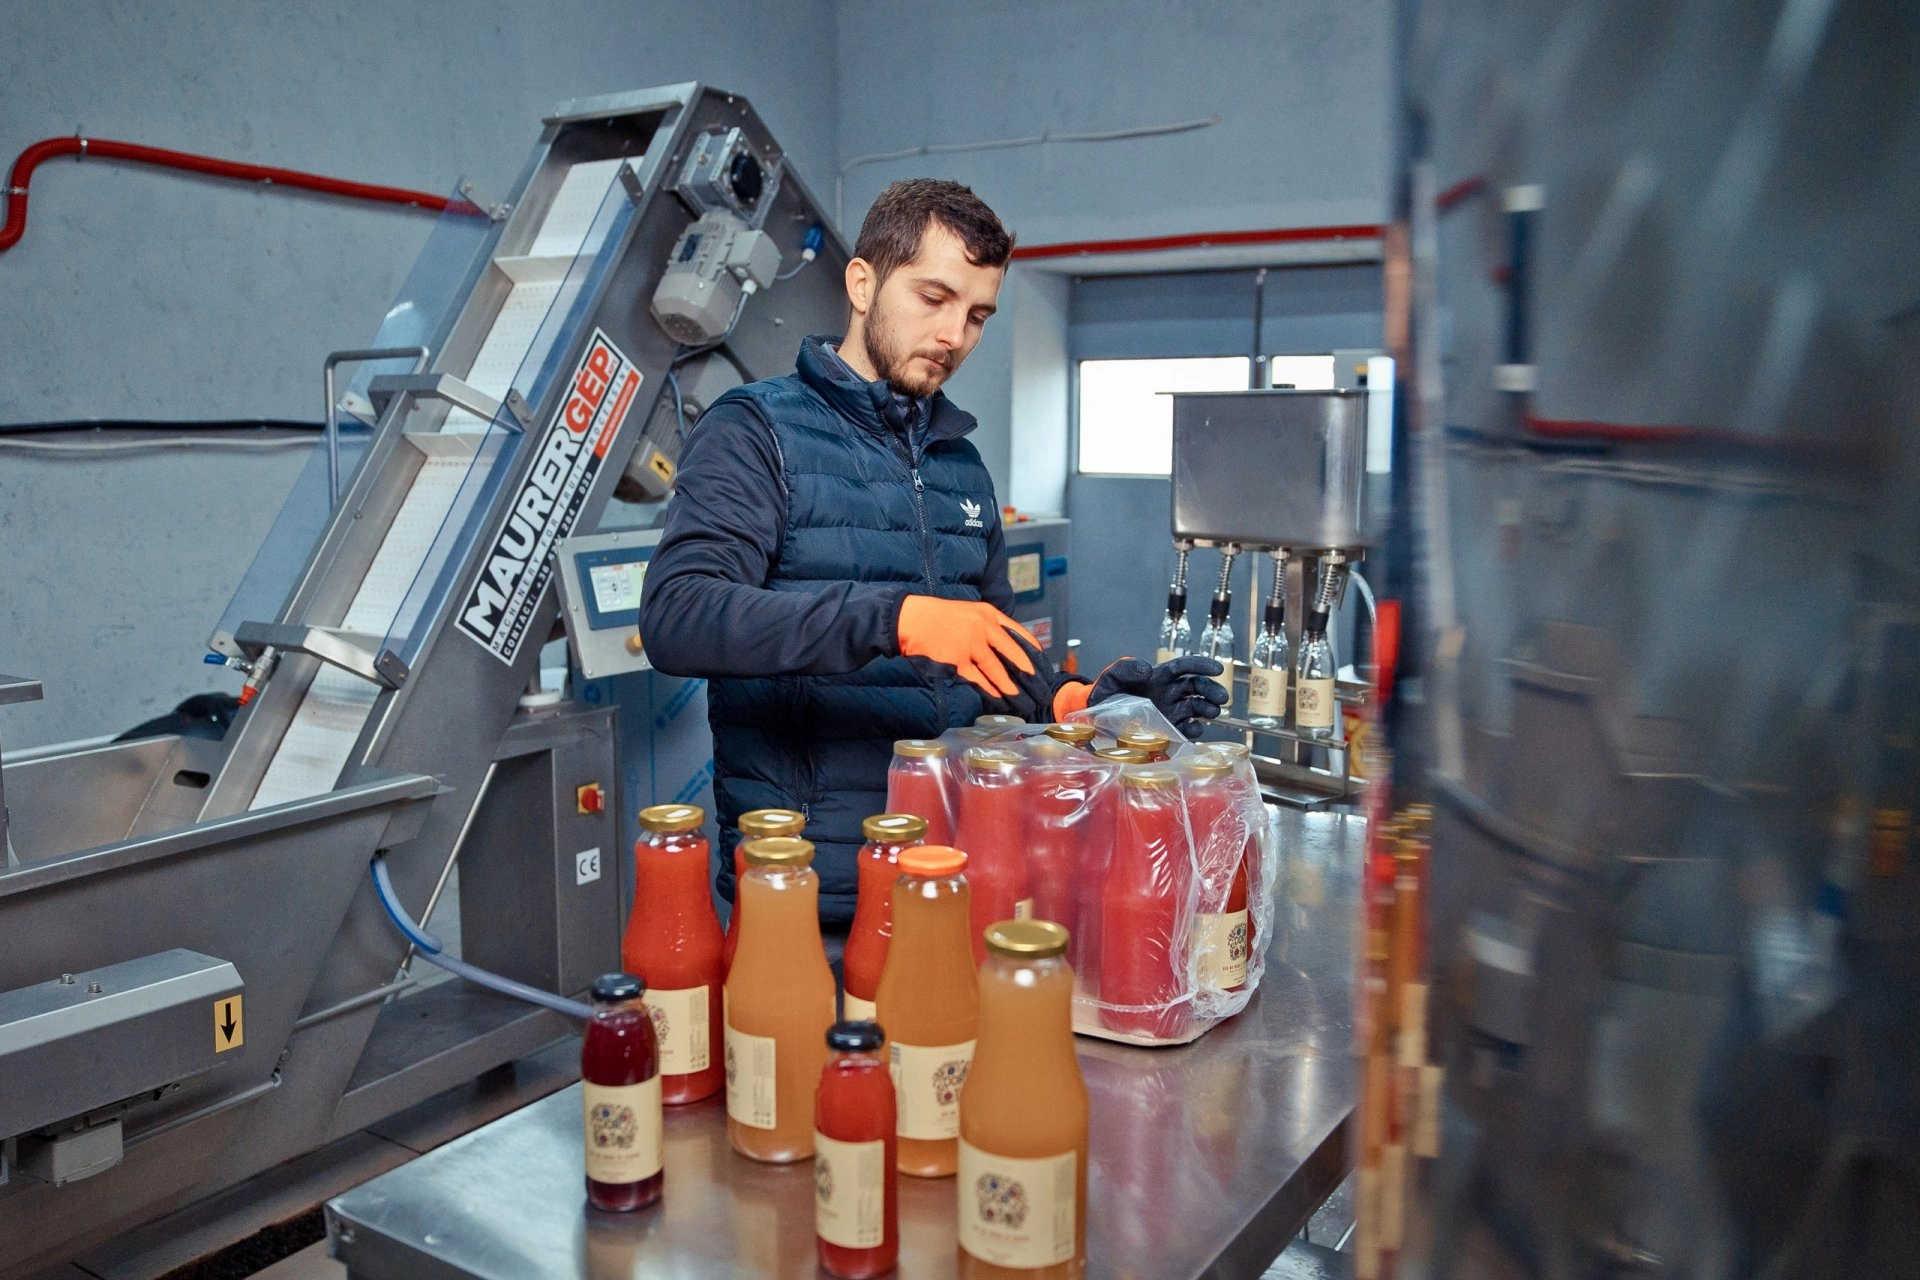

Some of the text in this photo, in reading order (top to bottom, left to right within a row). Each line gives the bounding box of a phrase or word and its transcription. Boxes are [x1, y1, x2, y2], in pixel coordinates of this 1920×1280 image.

[490, 360, 631, 651] MACHINERY FOR FRUIT PROCESSING
[964, 518, 983, 528] adidas
[503, 592, 537, 656] CONTACT:
[579, 855, 598, 876] CE
